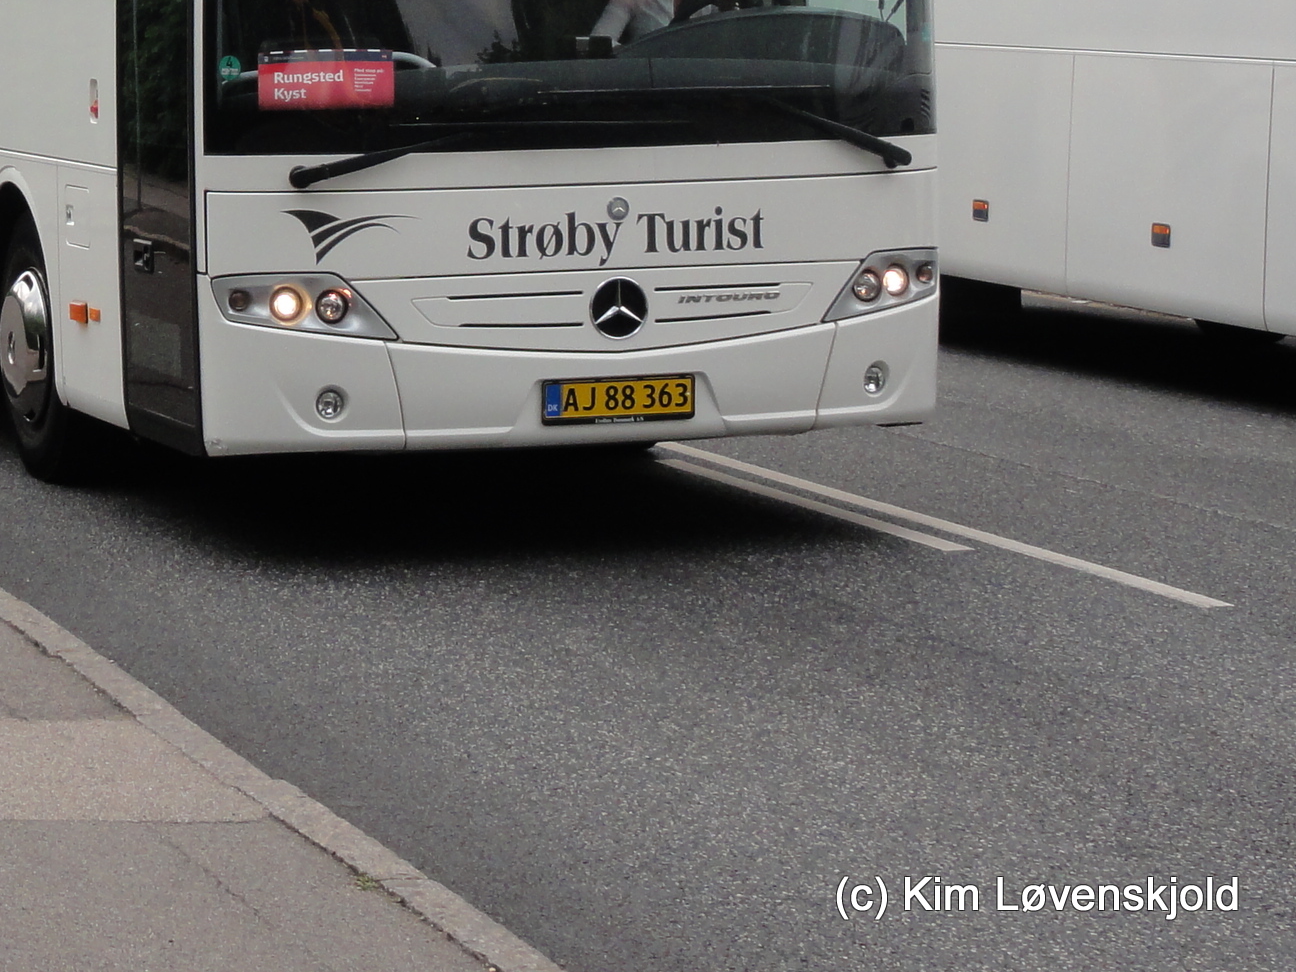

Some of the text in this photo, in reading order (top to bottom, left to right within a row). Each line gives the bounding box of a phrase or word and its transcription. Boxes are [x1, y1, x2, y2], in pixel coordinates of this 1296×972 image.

[273, 69, 344, 85] Rungsted
[274, 87, 307, 103] Kyst
[466, 205, 765, 267] Strøby Turist
[677, 292, 781, 304] INTOURO
[547, 382, 689, 412] DK AJ 88 363
